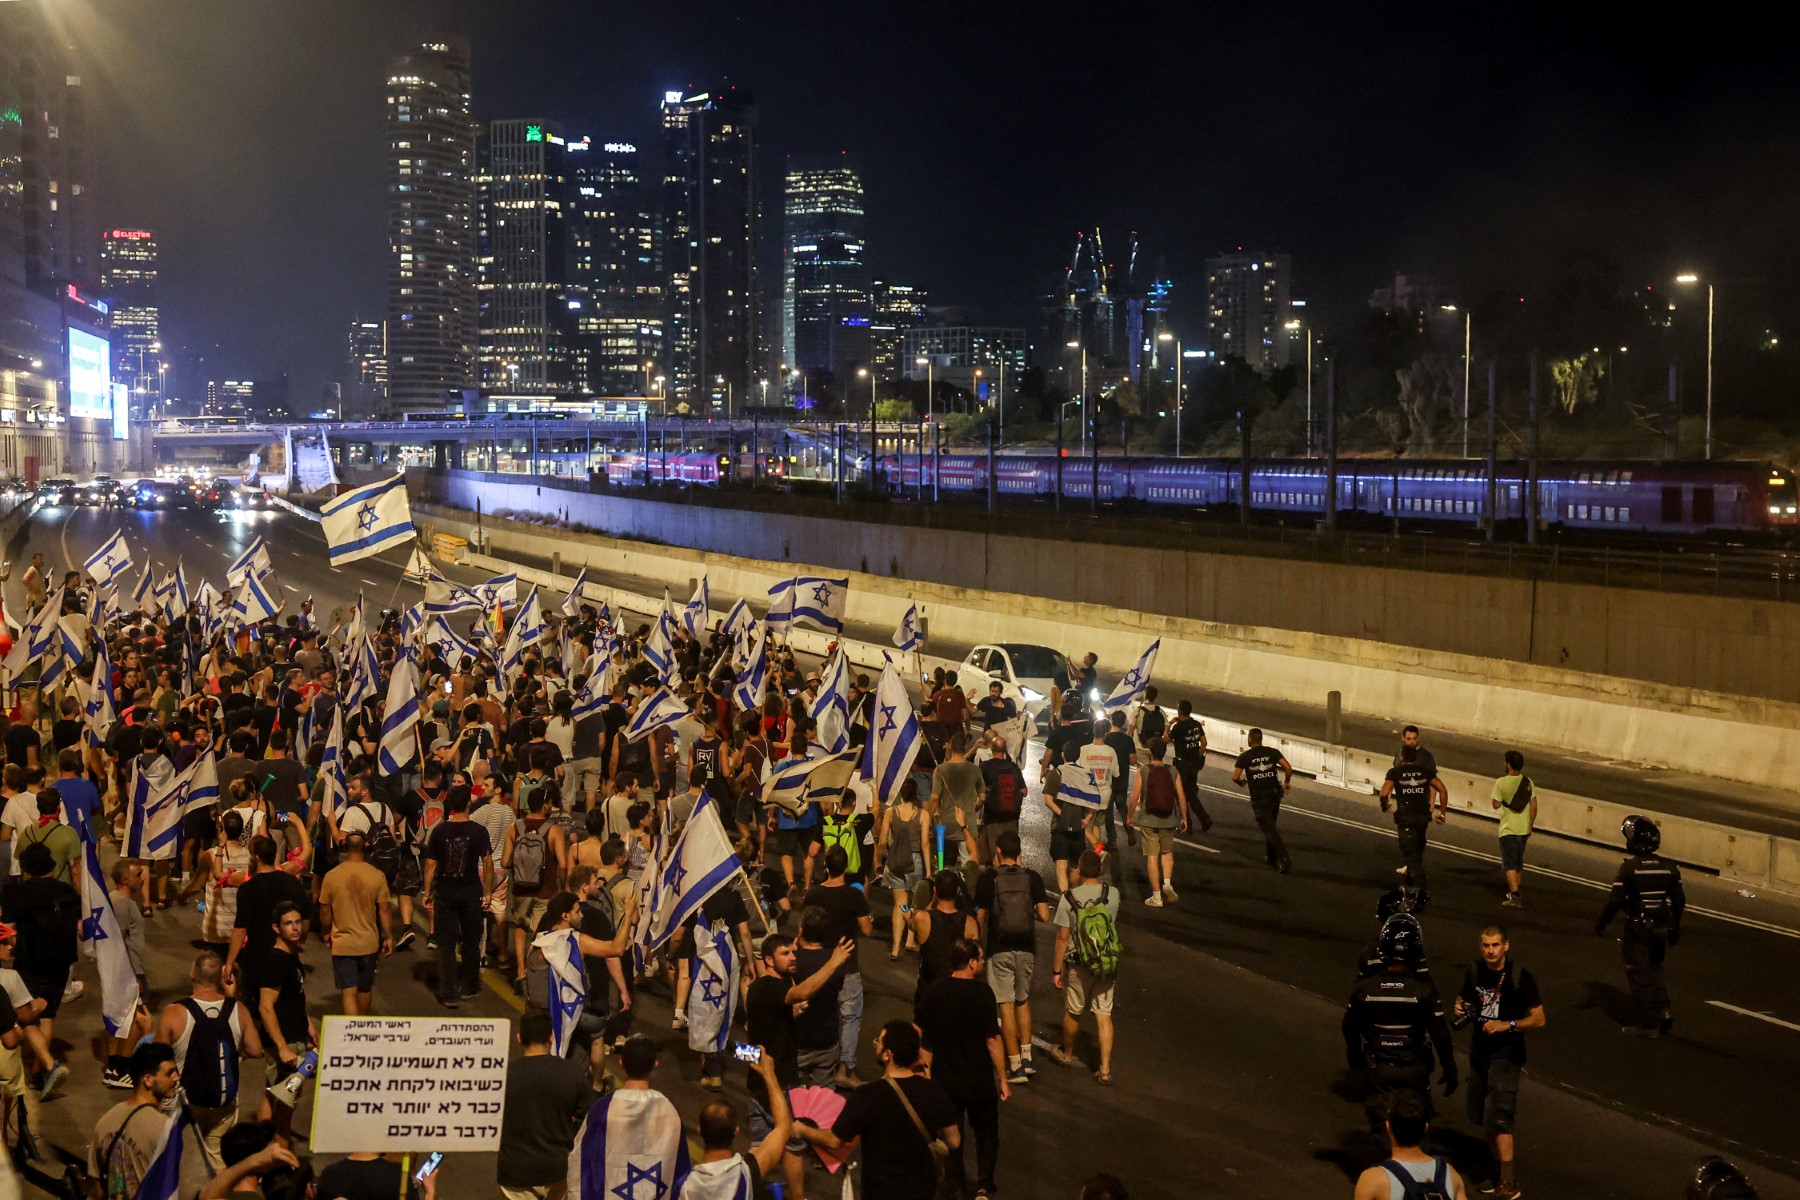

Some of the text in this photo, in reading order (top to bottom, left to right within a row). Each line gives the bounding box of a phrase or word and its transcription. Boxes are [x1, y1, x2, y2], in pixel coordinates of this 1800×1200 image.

[666, 91, 683, 103] EY
[698, 752, 712, 761] RV
[345, 1020, 411, 1030] ראשי המשק,
[436, 1024, 494, 1033] ההסתדרות,
[343, 1032, 381, 1042] ישראל:
[424, 1037, 494, 1046] ועדי העובדים,
[322, 1054, 505, 1071] אם לא תשמיעו קולכם,
[385, 1077, 436, 1094] לקחת
[439, 1079, 503, 1092] כשיבואו
[346, 1100, 501, 1114] כבר לא יוותר אדם
[387, 1124, 498, 1138] לדבר בעדכם
